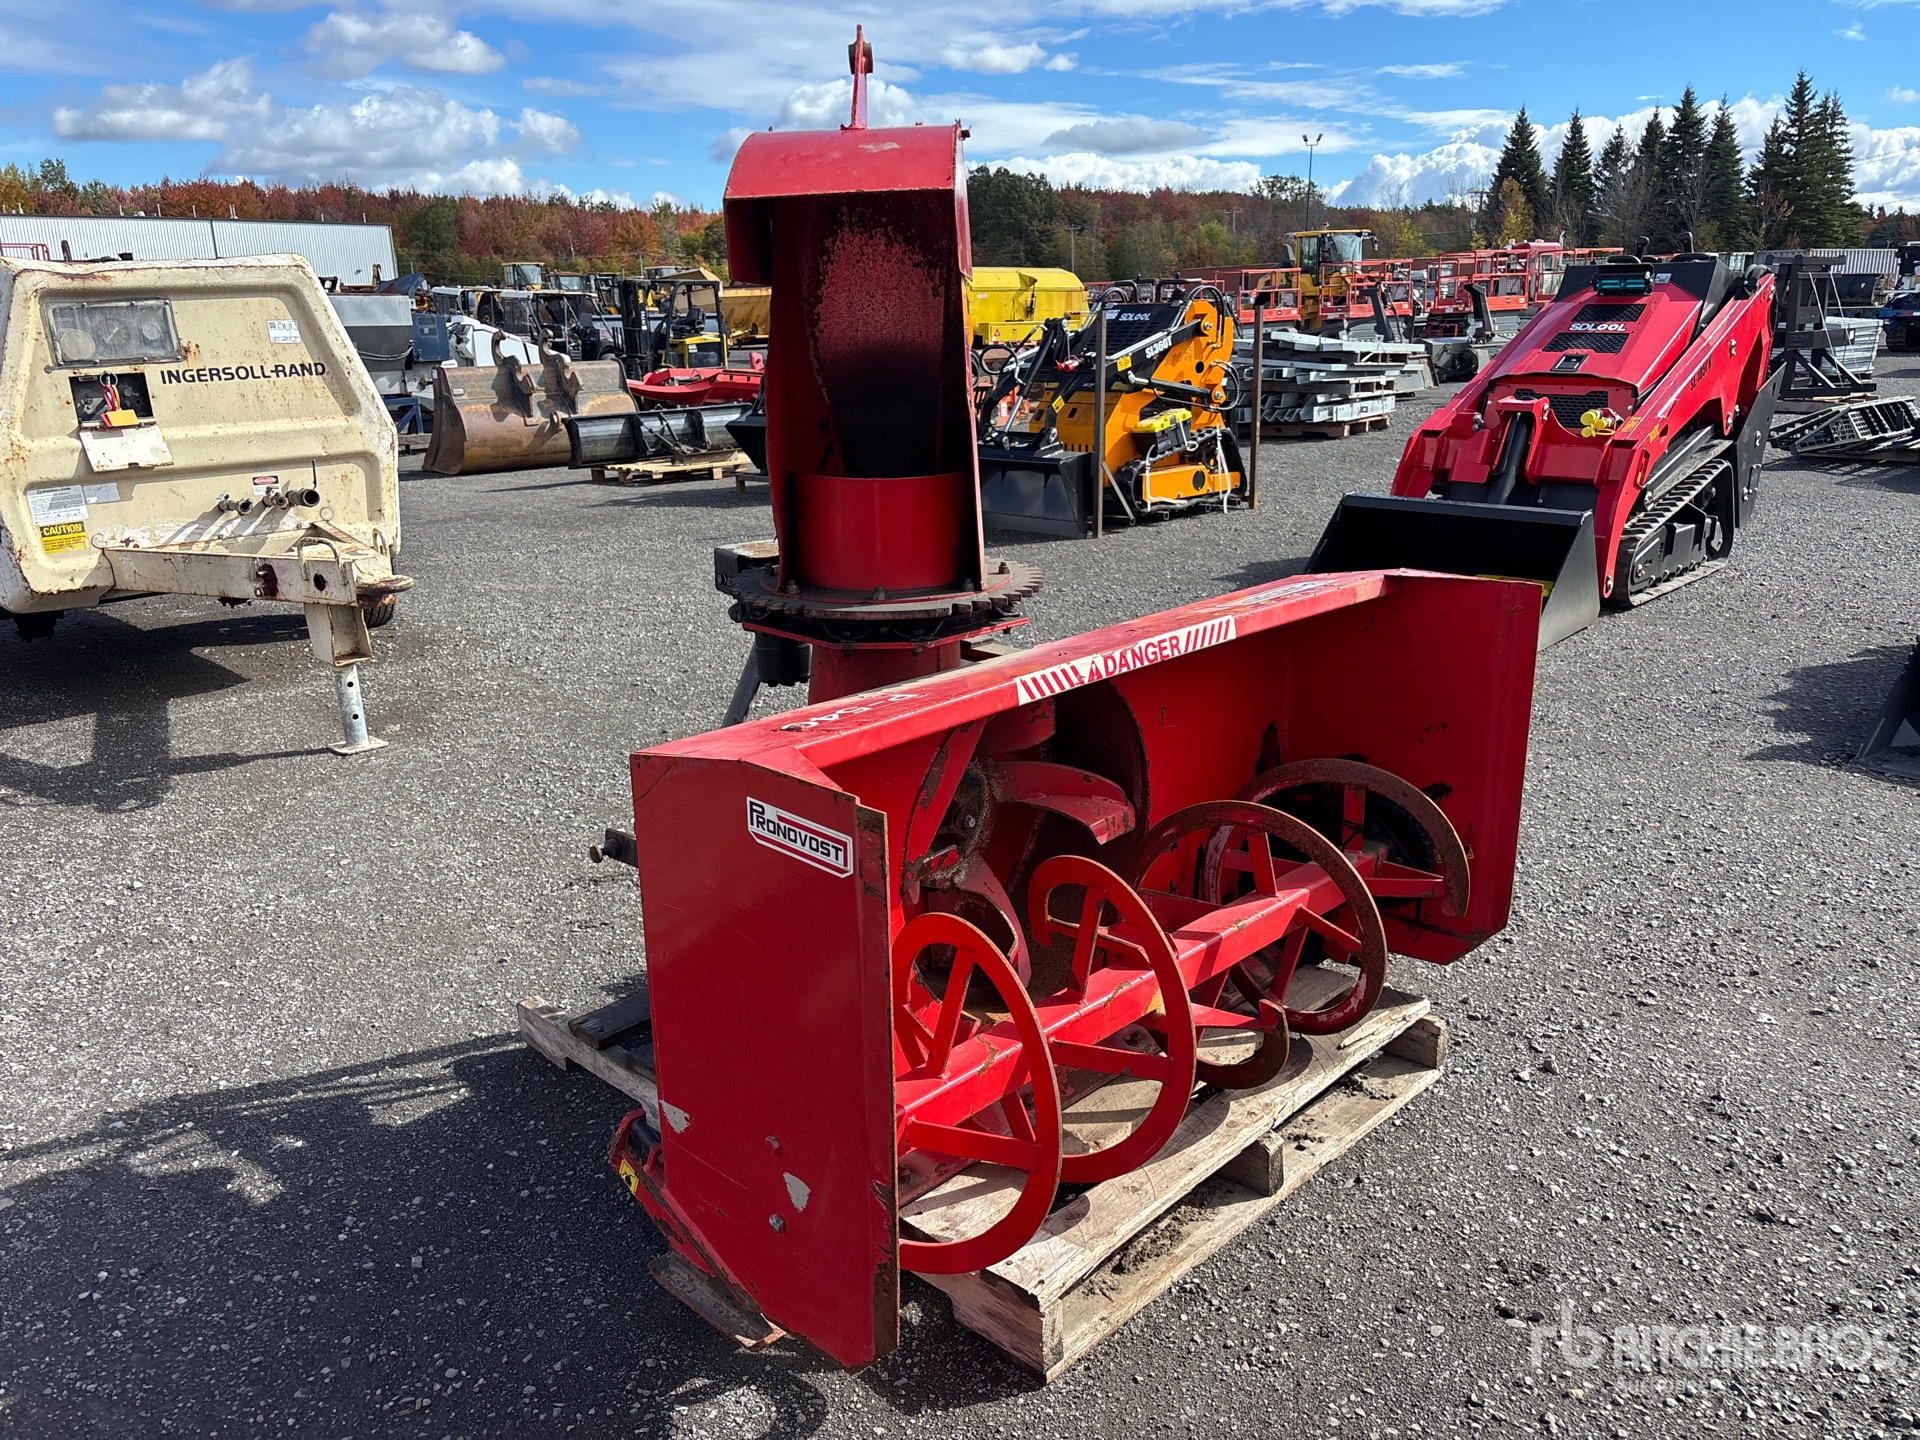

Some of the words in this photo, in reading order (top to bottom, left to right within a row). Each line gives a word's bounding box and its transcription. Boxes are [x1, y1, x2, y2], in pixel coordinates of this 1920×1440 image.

[1569, 323, 1626, 331] SDLOOL
[1145, 336, 1172, 359] SL360T
[160, 362, 326, 384] INGERSOLL-RAND
[43, 523, 82, 536] CAUTION
[1103, 635, 1182, 677] DANGER
[749, 800, 842, 861] PRONOVOST
